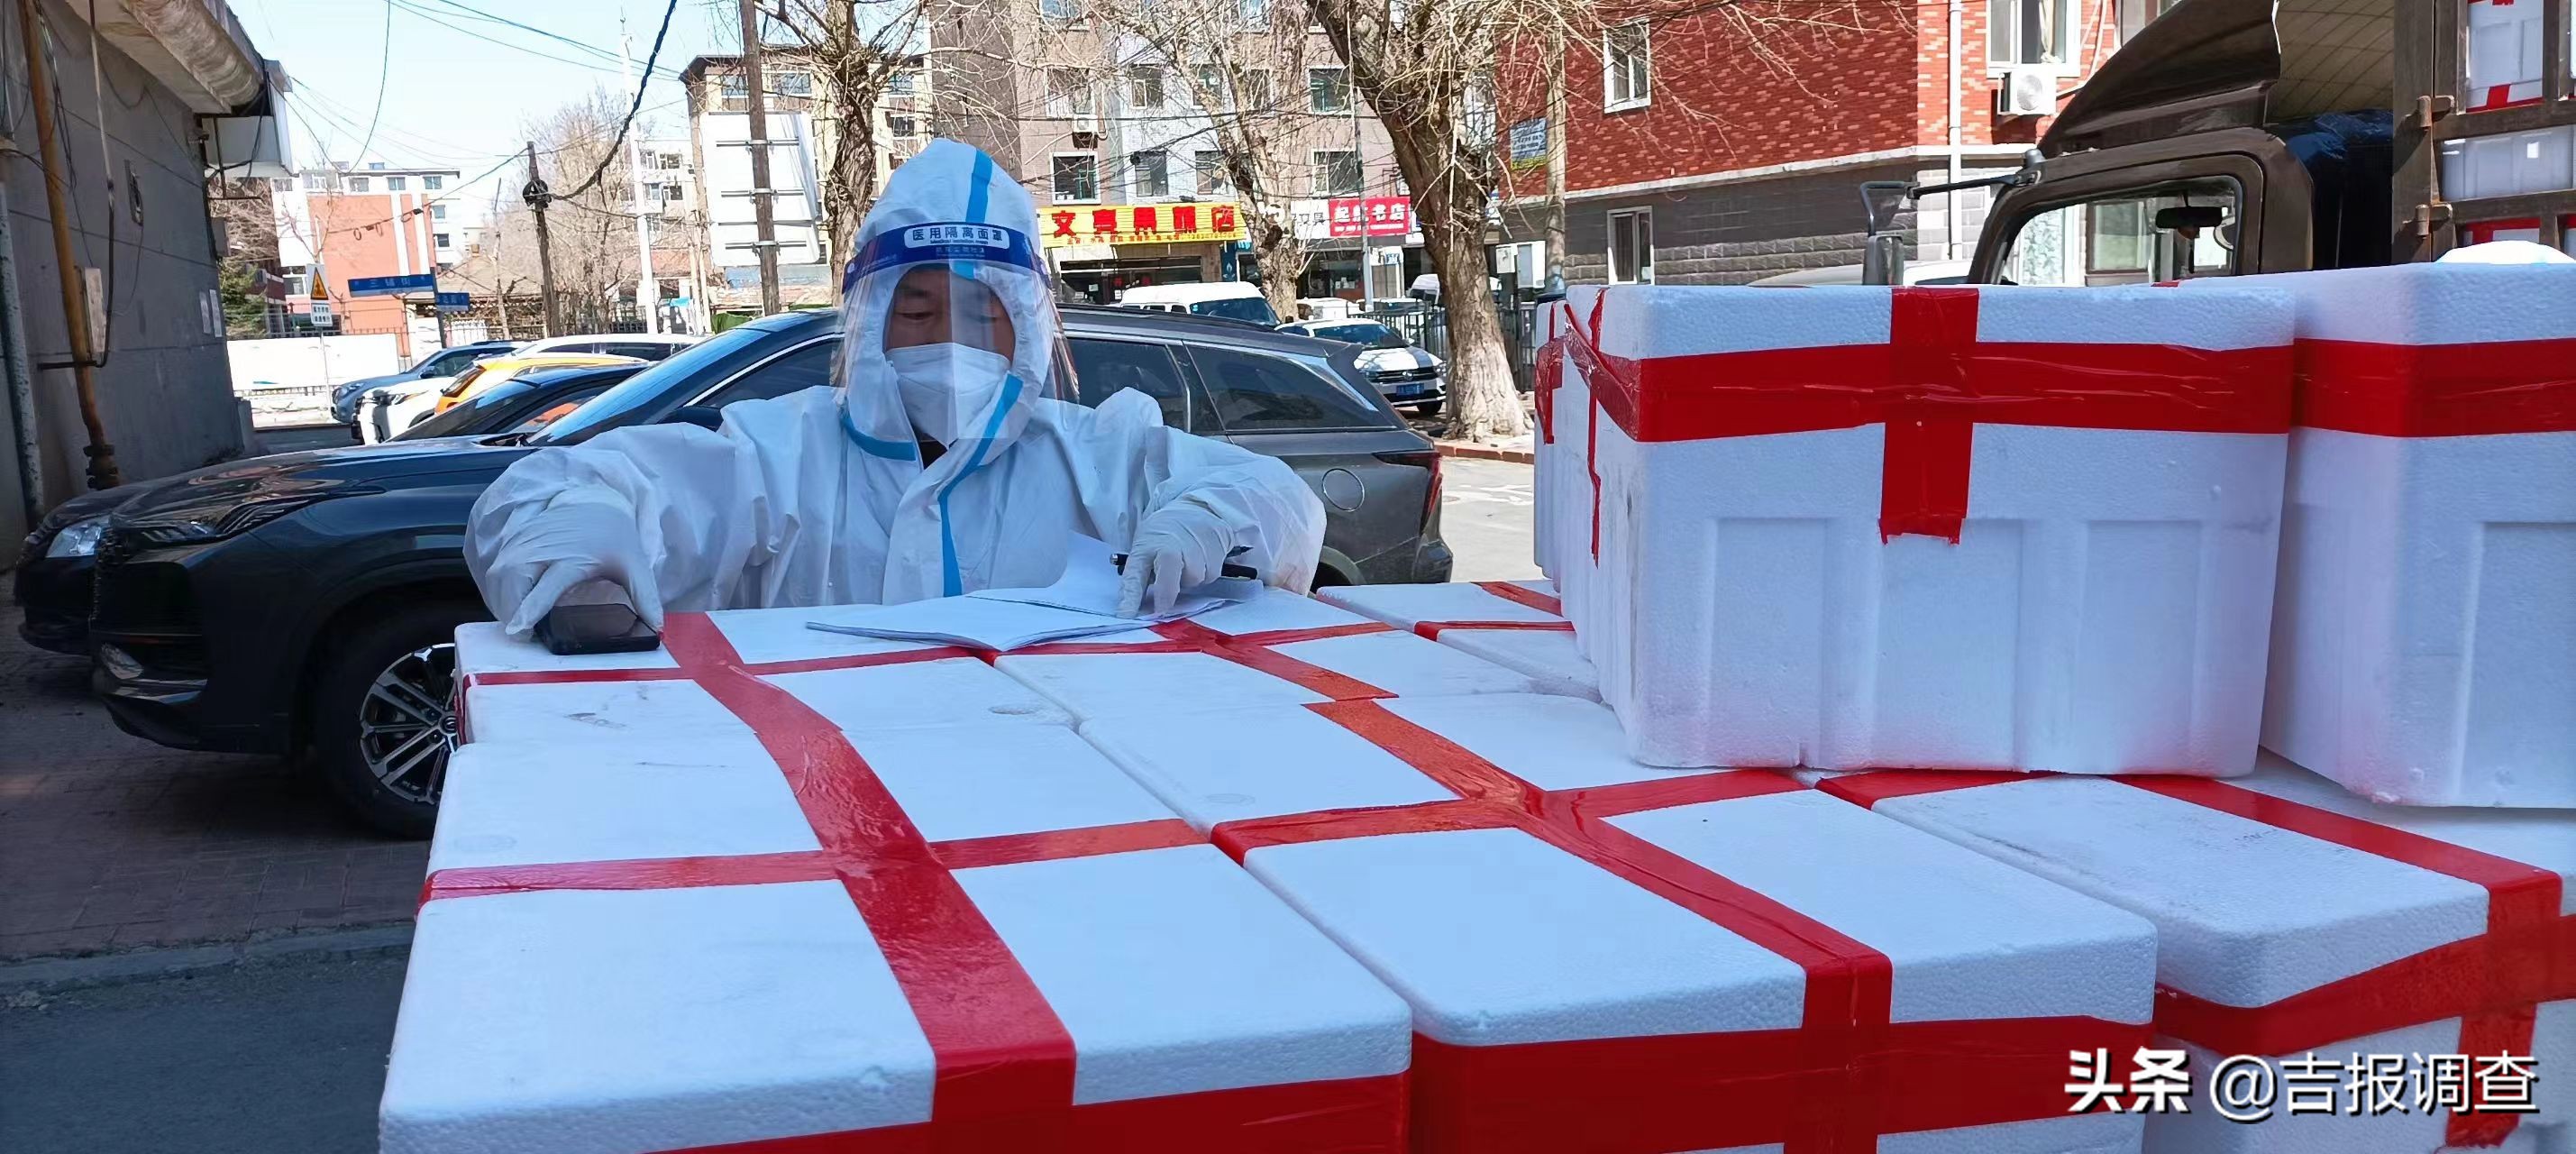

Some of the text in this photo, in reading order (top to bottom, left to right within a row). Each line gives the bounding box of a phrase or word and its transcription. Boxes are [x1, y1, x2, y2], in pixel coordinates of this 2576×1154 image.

[912, 226, 1003, 242] 医用隔离面罩
